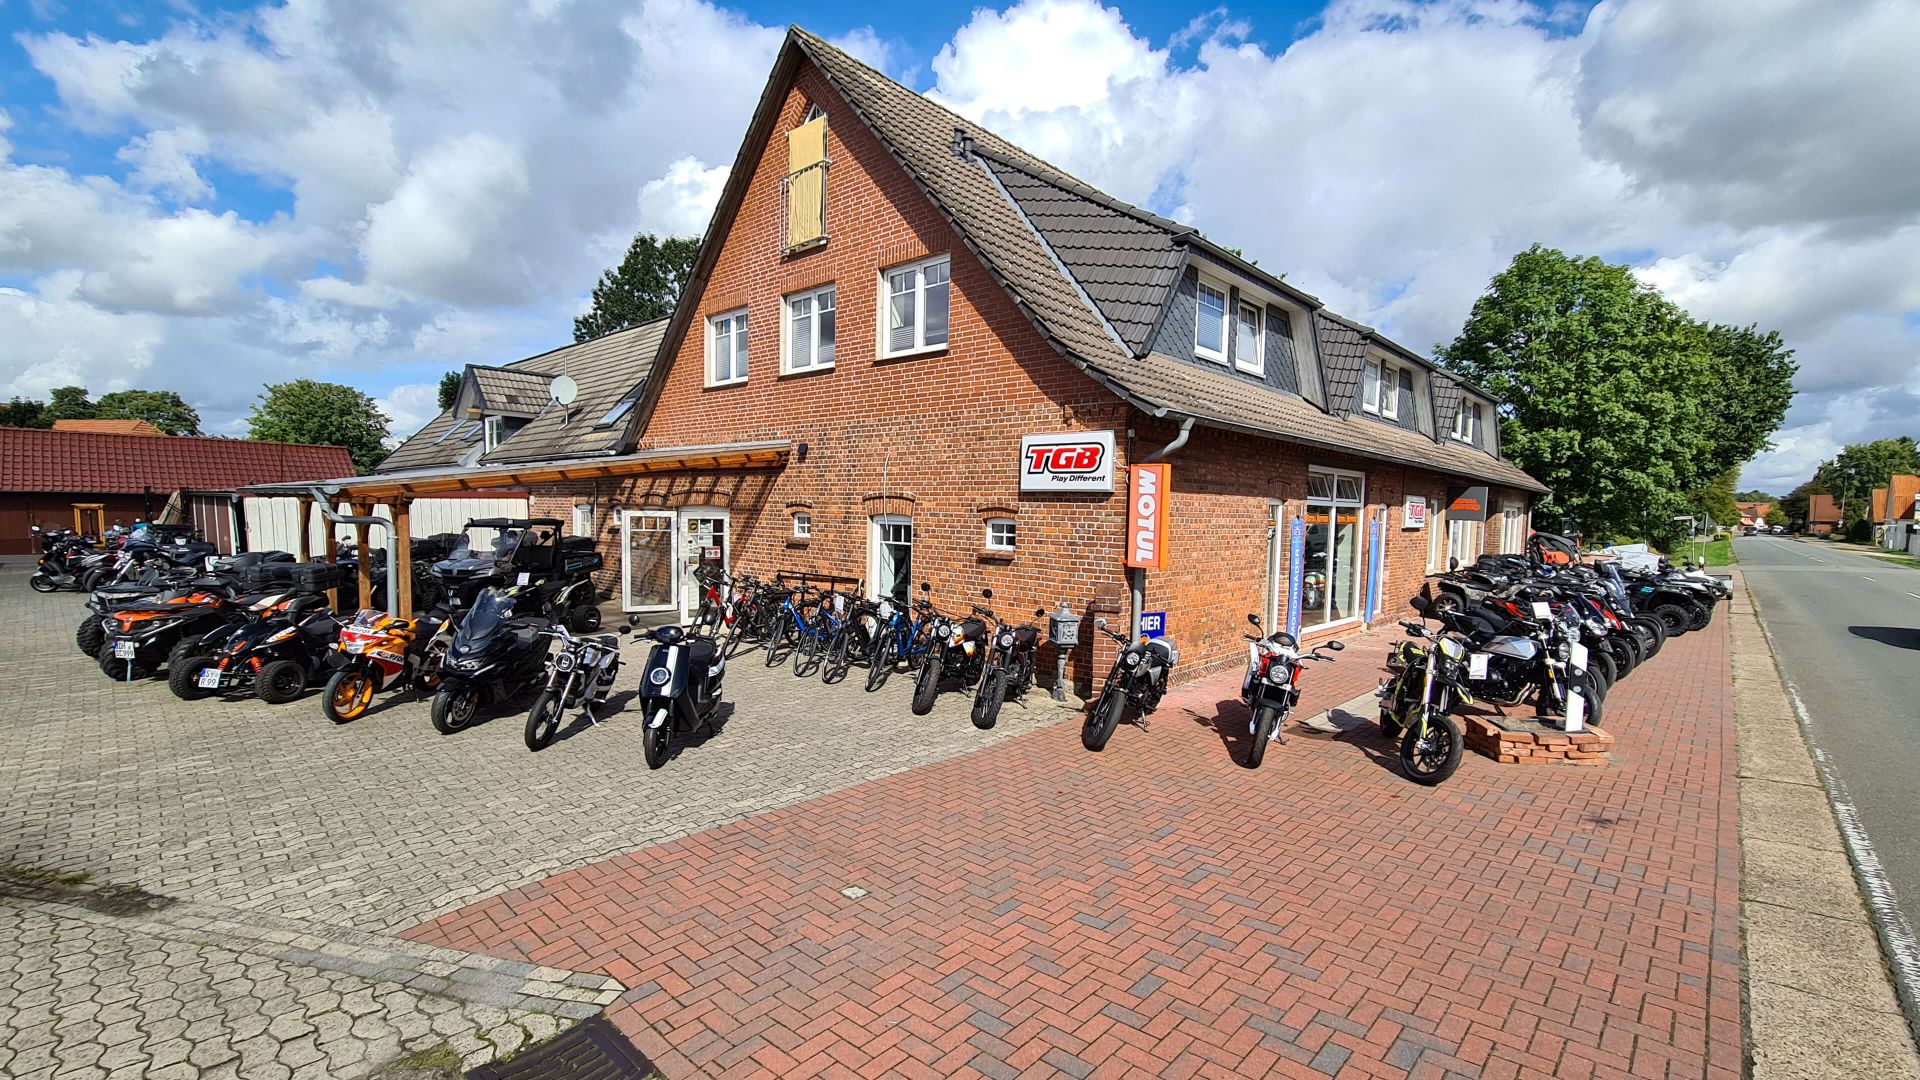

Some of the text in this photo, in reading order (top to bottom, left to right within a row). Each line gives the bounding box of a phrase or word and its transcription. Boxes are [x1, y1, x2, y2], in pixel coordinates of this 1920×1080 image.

[1030, 447, 1101, 470] TGB
[1051, 475, 1068, 483] Play
[1136, 469, 1156, 563] MOTUL
